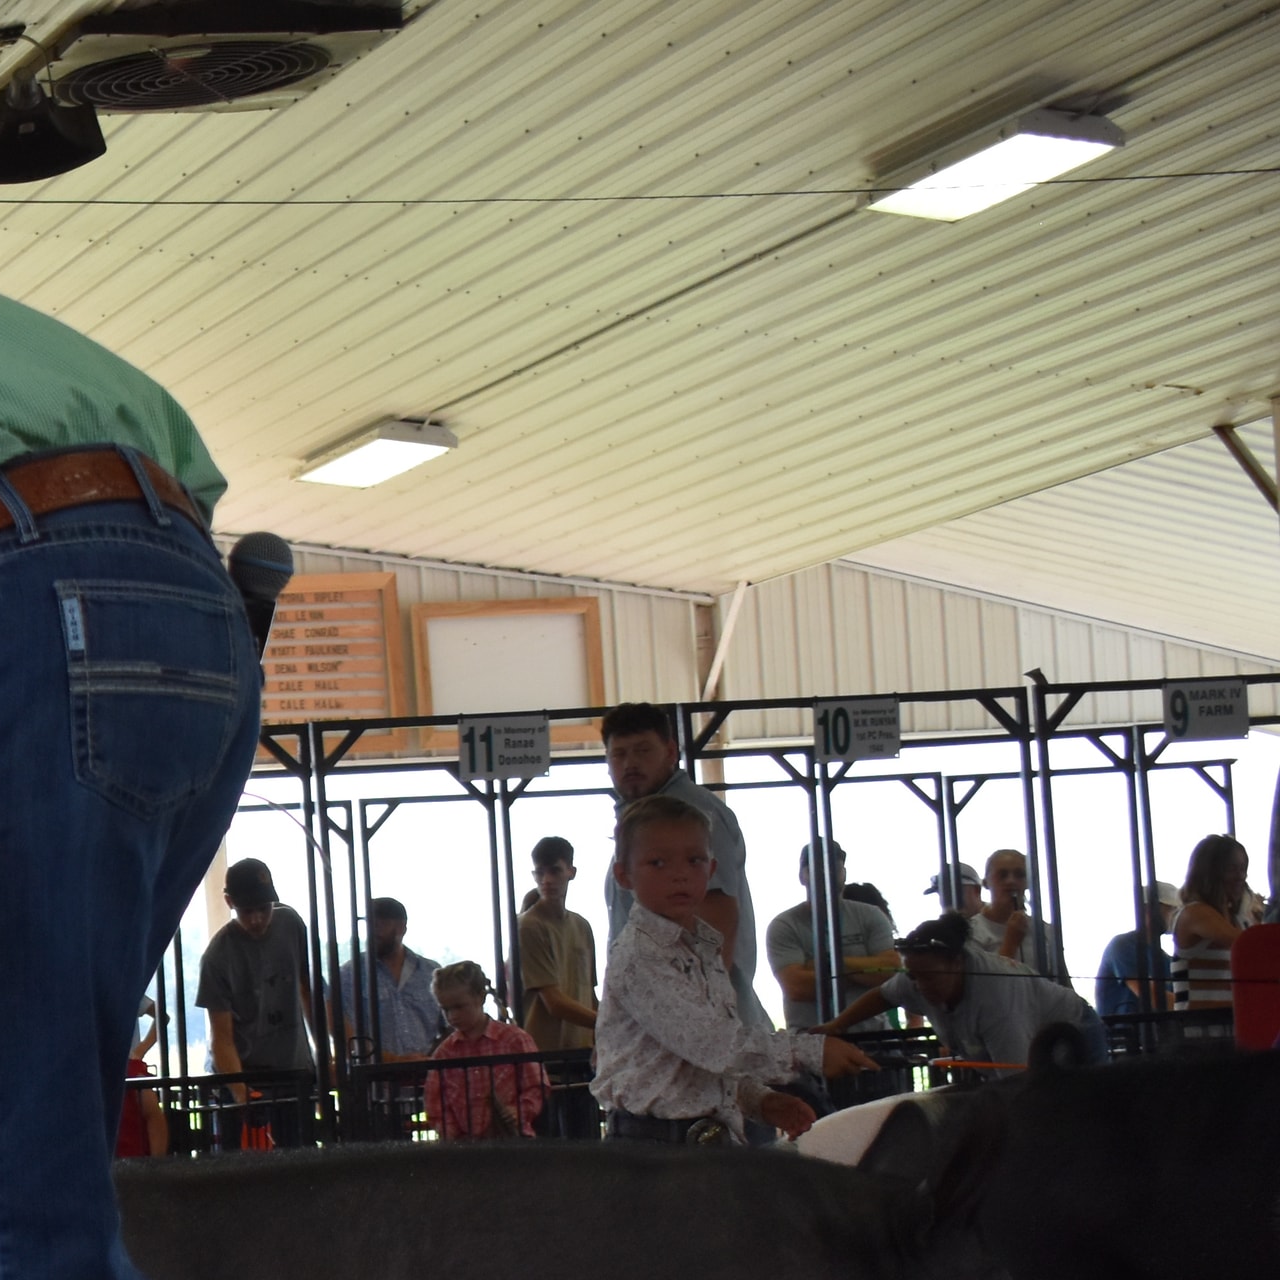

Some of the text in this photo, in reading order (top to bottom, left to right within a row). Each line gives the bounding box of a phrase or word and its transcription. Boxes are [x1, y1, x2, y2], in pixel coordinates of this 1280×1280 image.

[279, 680, 340, 691] CALE HALL
[1189, 688, 1240, 700] MARK IV
[280, 700, 305, 710] CALE
[1199, 705, 1233, 716] FARM
[1170, 690, 1188, 737] 9
[817, 707, 850, 755] 10
[462, 726, 493, 773] 11
